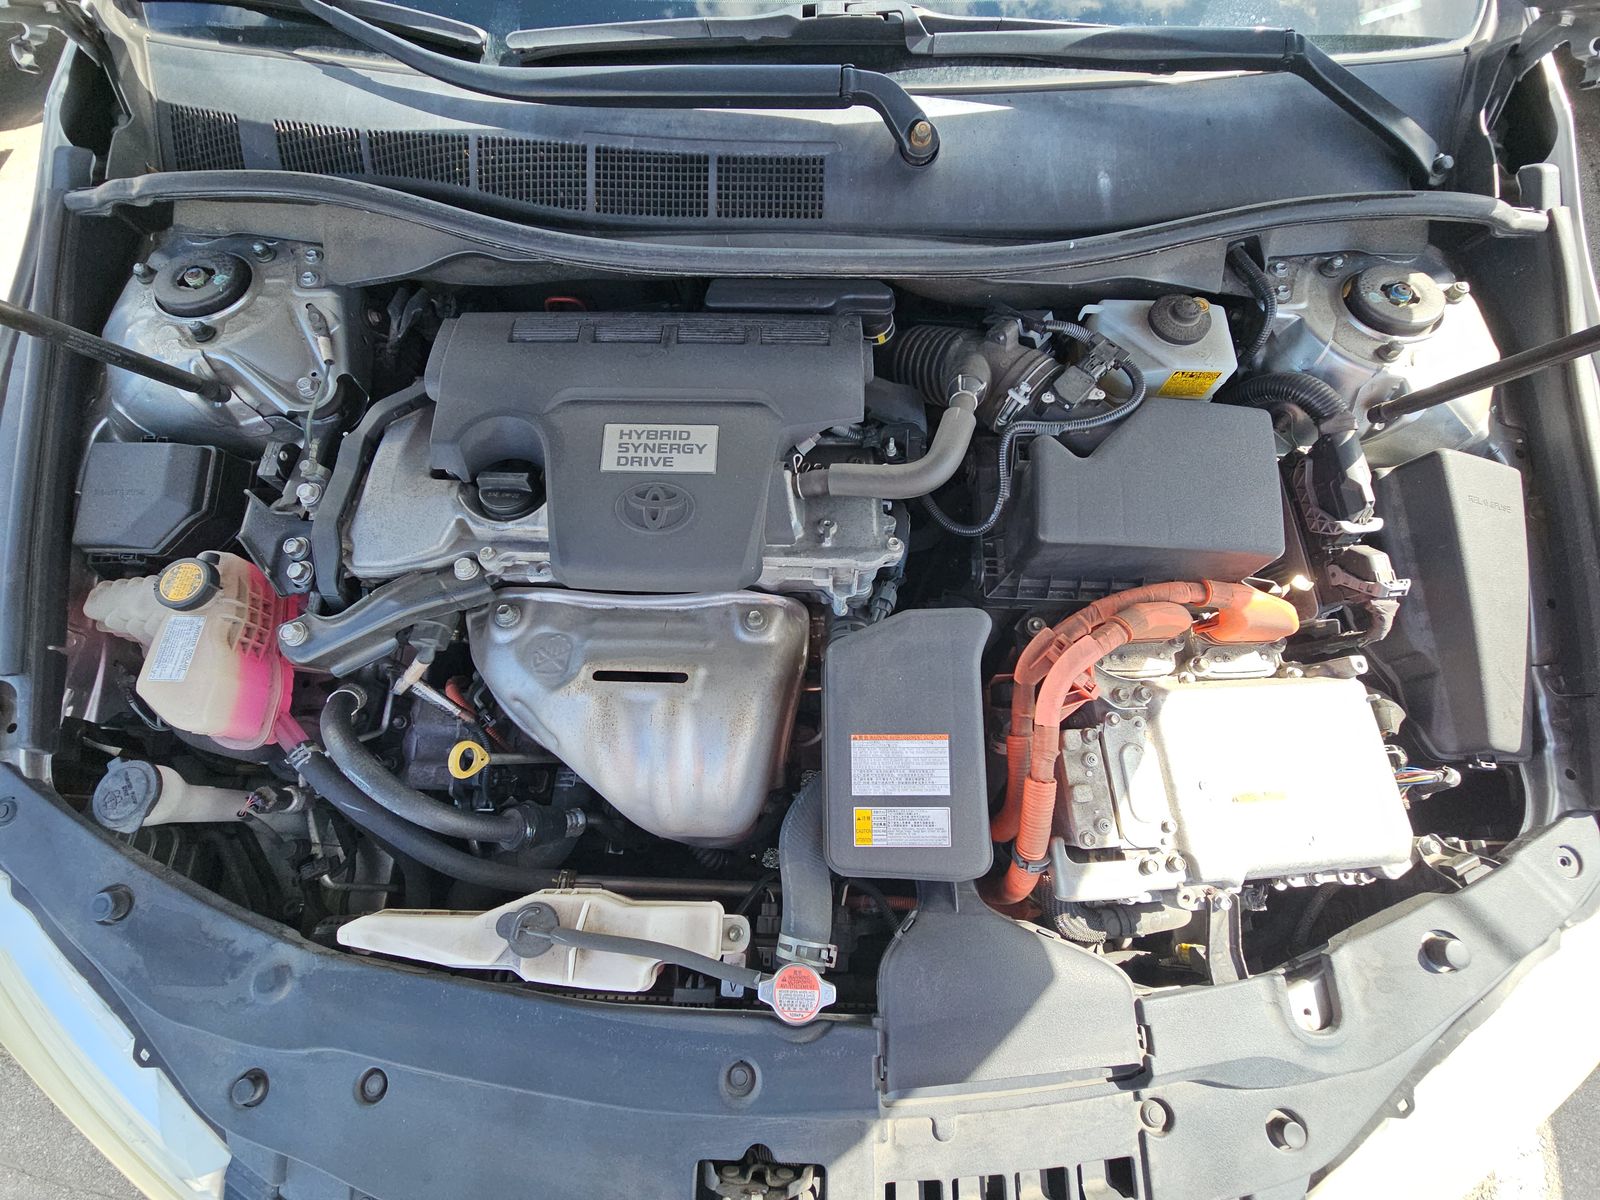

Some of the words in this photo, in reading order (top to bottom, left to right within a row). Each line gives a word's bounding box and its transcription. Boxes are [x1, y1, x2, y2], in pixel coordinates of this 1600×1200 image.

[619, 429, 691, 440] HYBRID
[617, 442, 708, 454] SYNERGY
[616, 456, 674, 467] DRIVE
